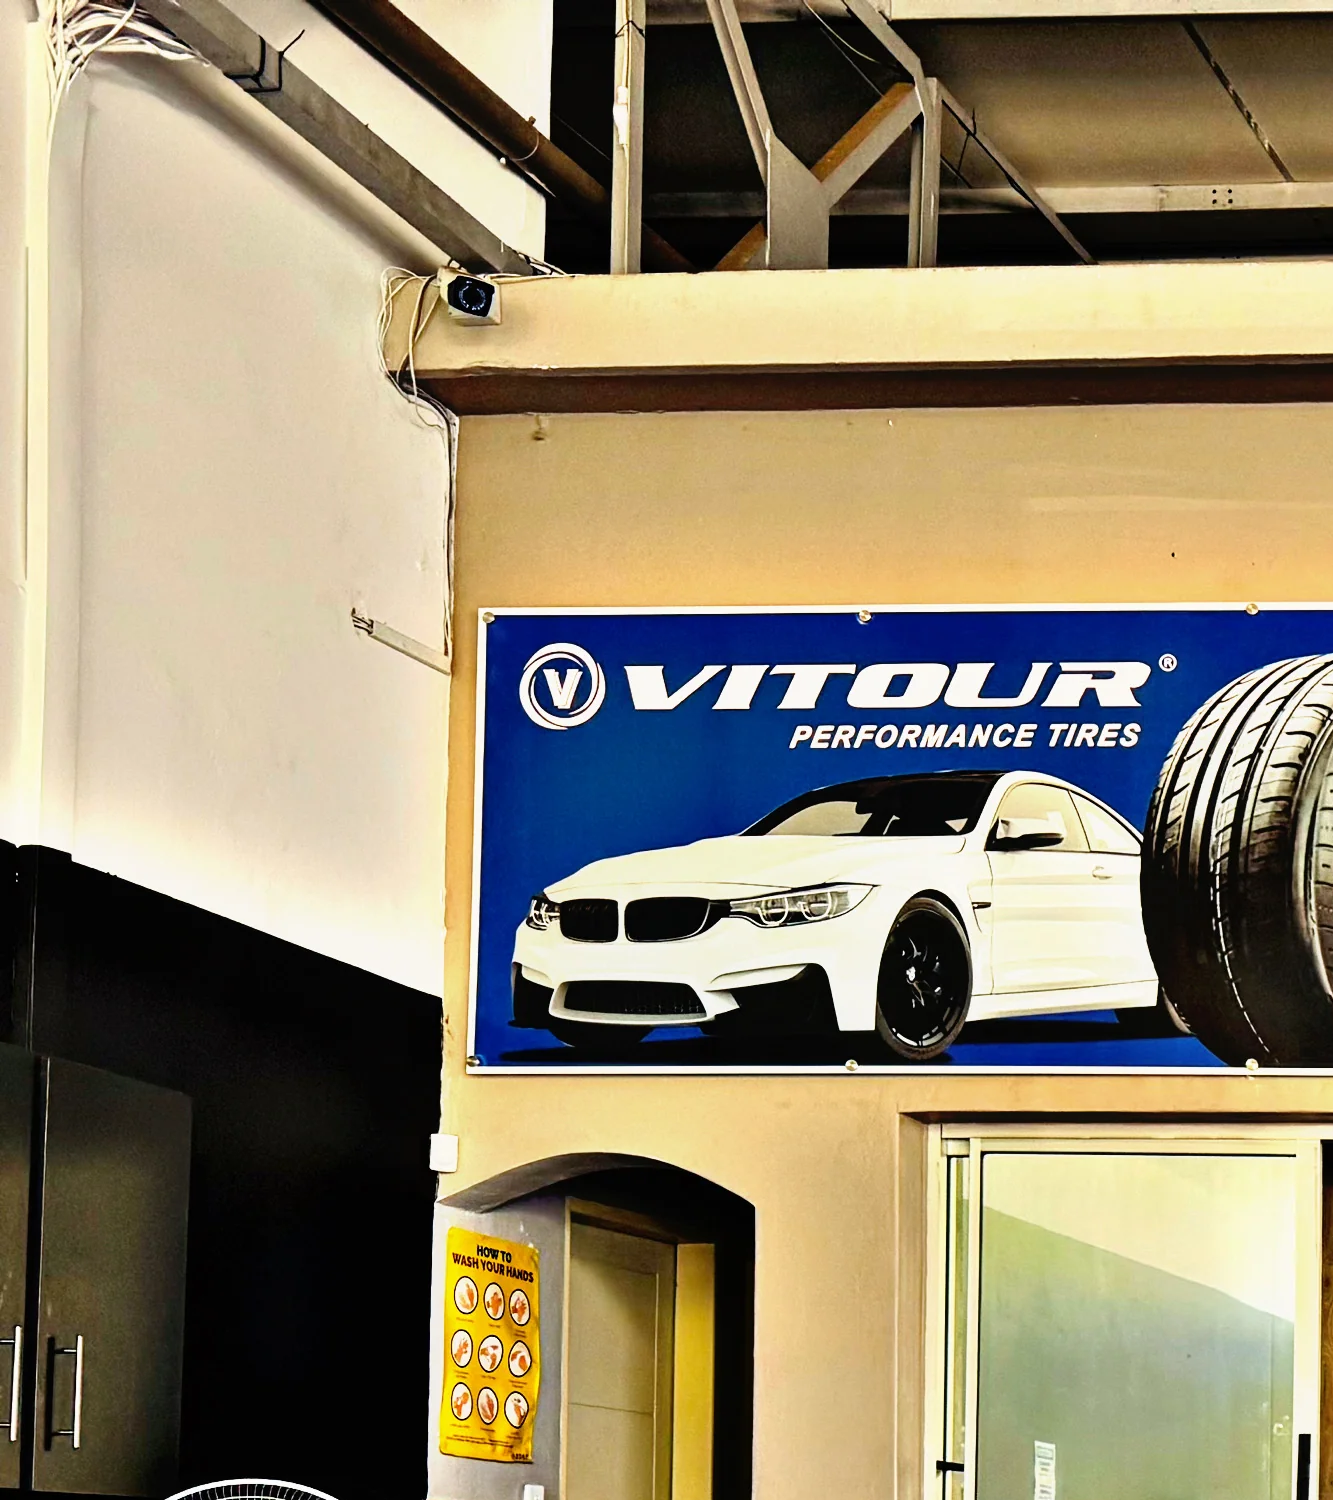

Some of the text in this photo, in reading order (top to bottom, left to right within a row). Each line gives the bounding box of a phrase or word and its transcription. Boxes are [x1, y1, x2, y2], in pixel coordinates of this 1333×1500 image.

[624, 662, 1151, 710] VITOUR
[789, 722, 1142, 749] PERFORMANCE TIRES
[452, 1252, 534, 1283] WASH YOUR HANDS
[476, 1244, 512, 1263] HOW TO
